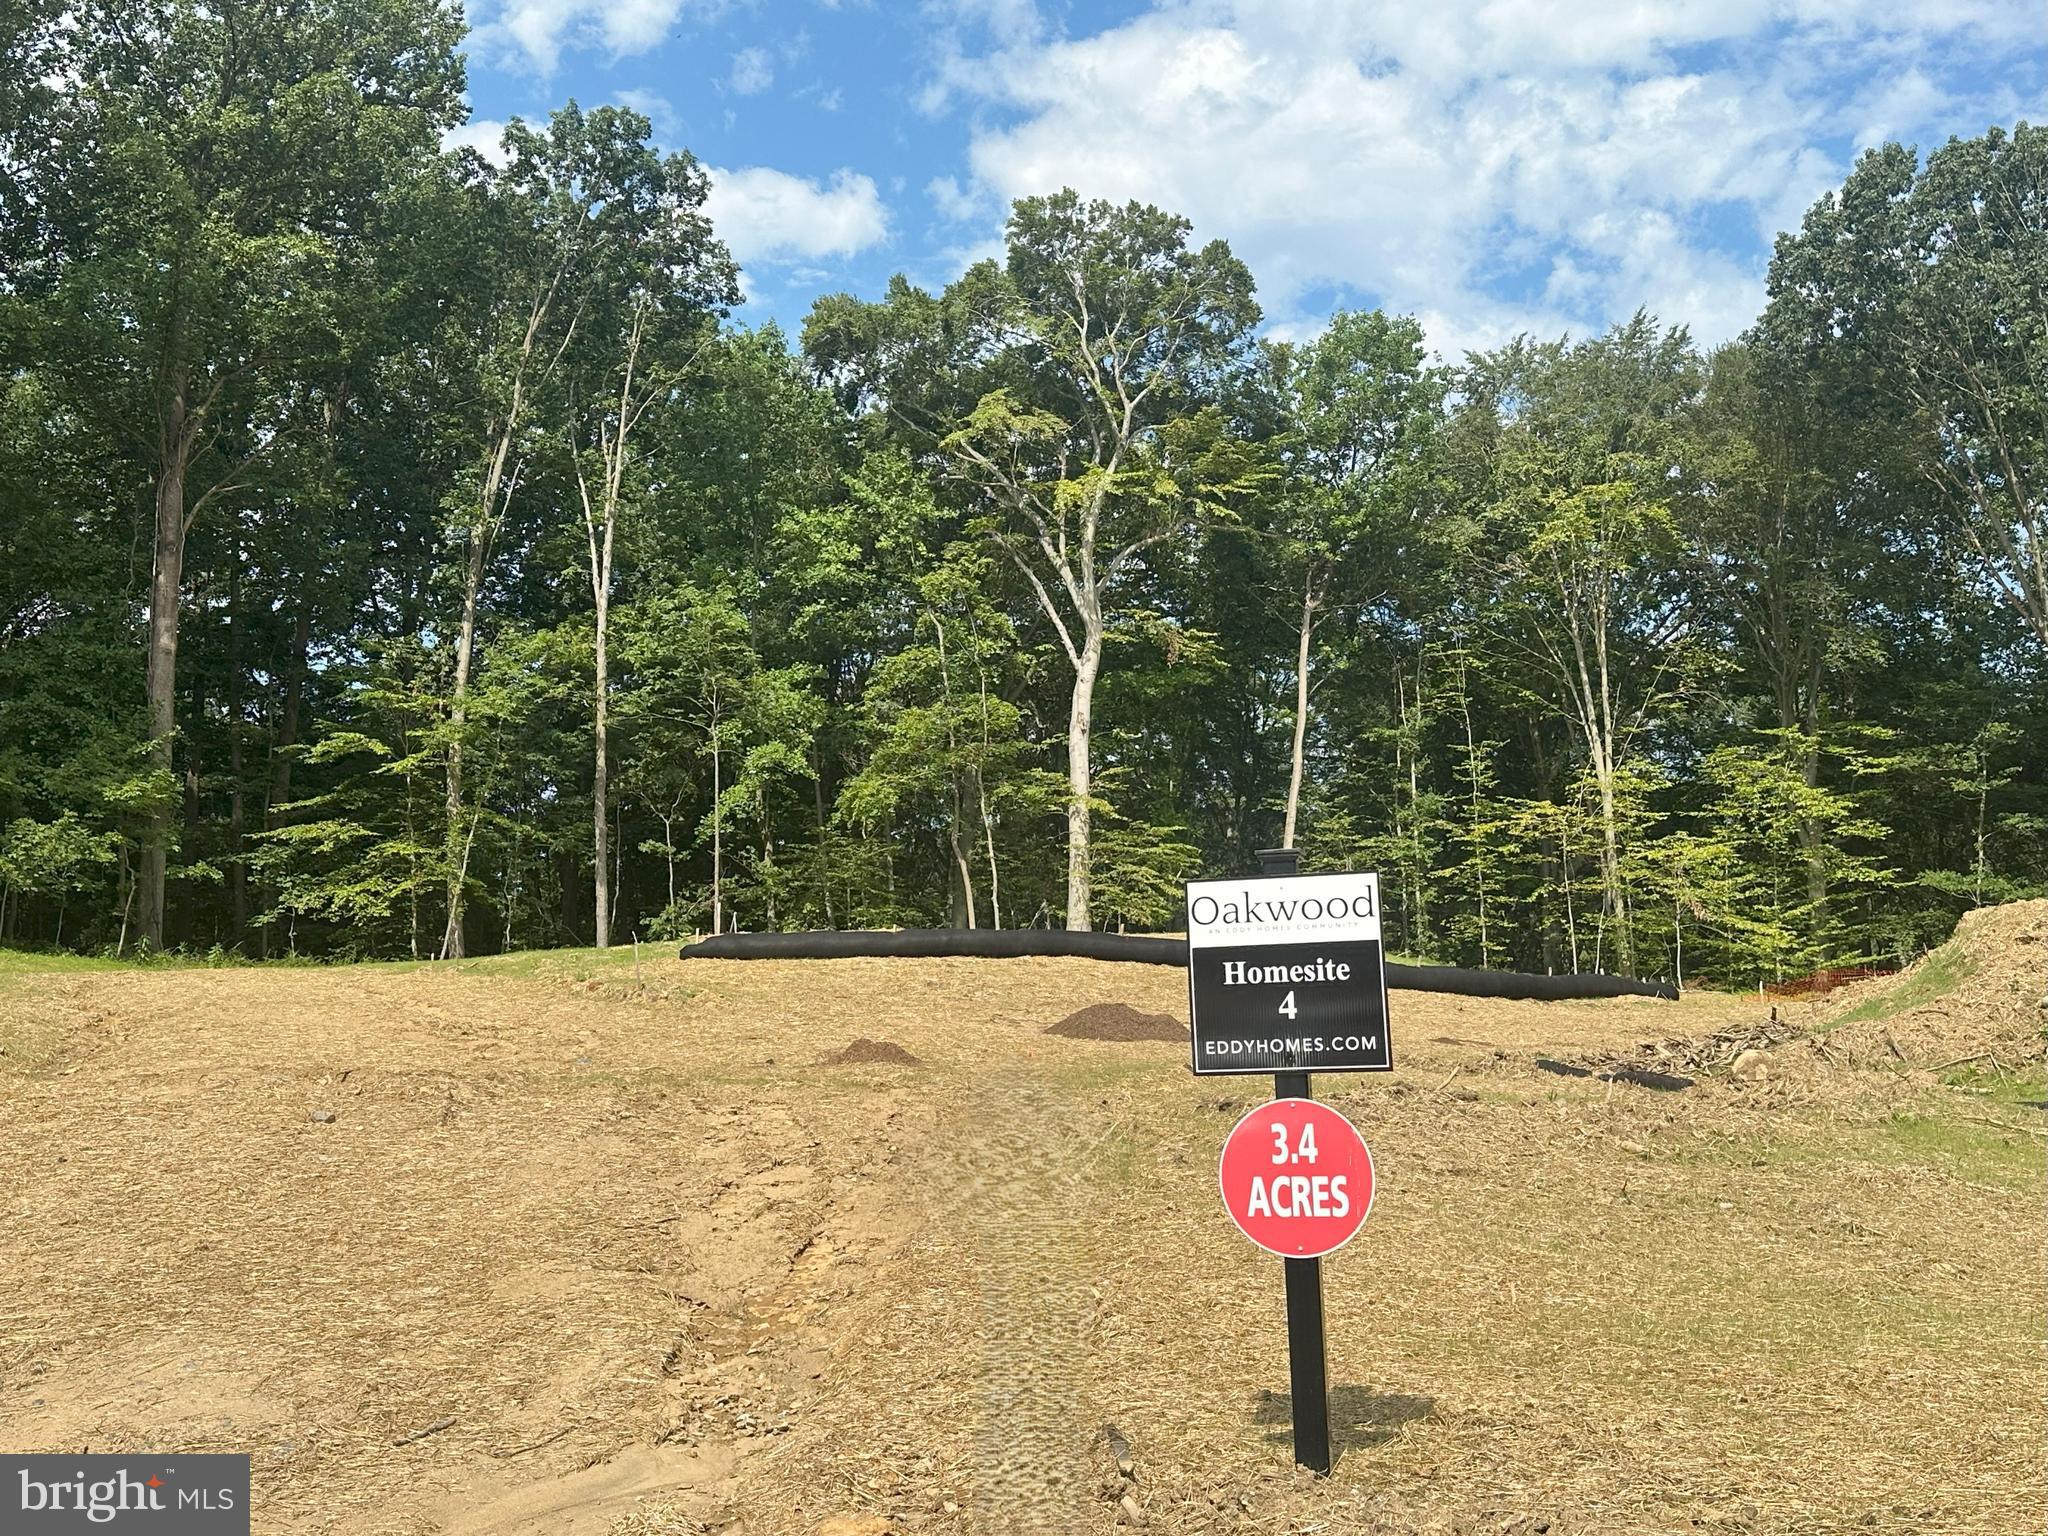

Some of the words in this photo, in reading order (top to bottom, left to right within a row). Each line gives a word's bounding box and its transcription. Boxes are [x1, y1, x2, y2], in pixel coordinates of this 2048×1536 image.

[1191, 885, 1376, 925] Oakwood
[1226, 926, 1251, 934] EDDY
[1296, 921, 1359, 931] COMMUNITY
[1222, 957, 1351, 985] Homesite
[1278, 990, 1298, 1020] 4
[1205, 1035, 1377, 1055] EDDYHOMES.COM
[1270, 1122, 1319, 1165] 3.4
[1247, 1175, 1350, 1218] ACRES
